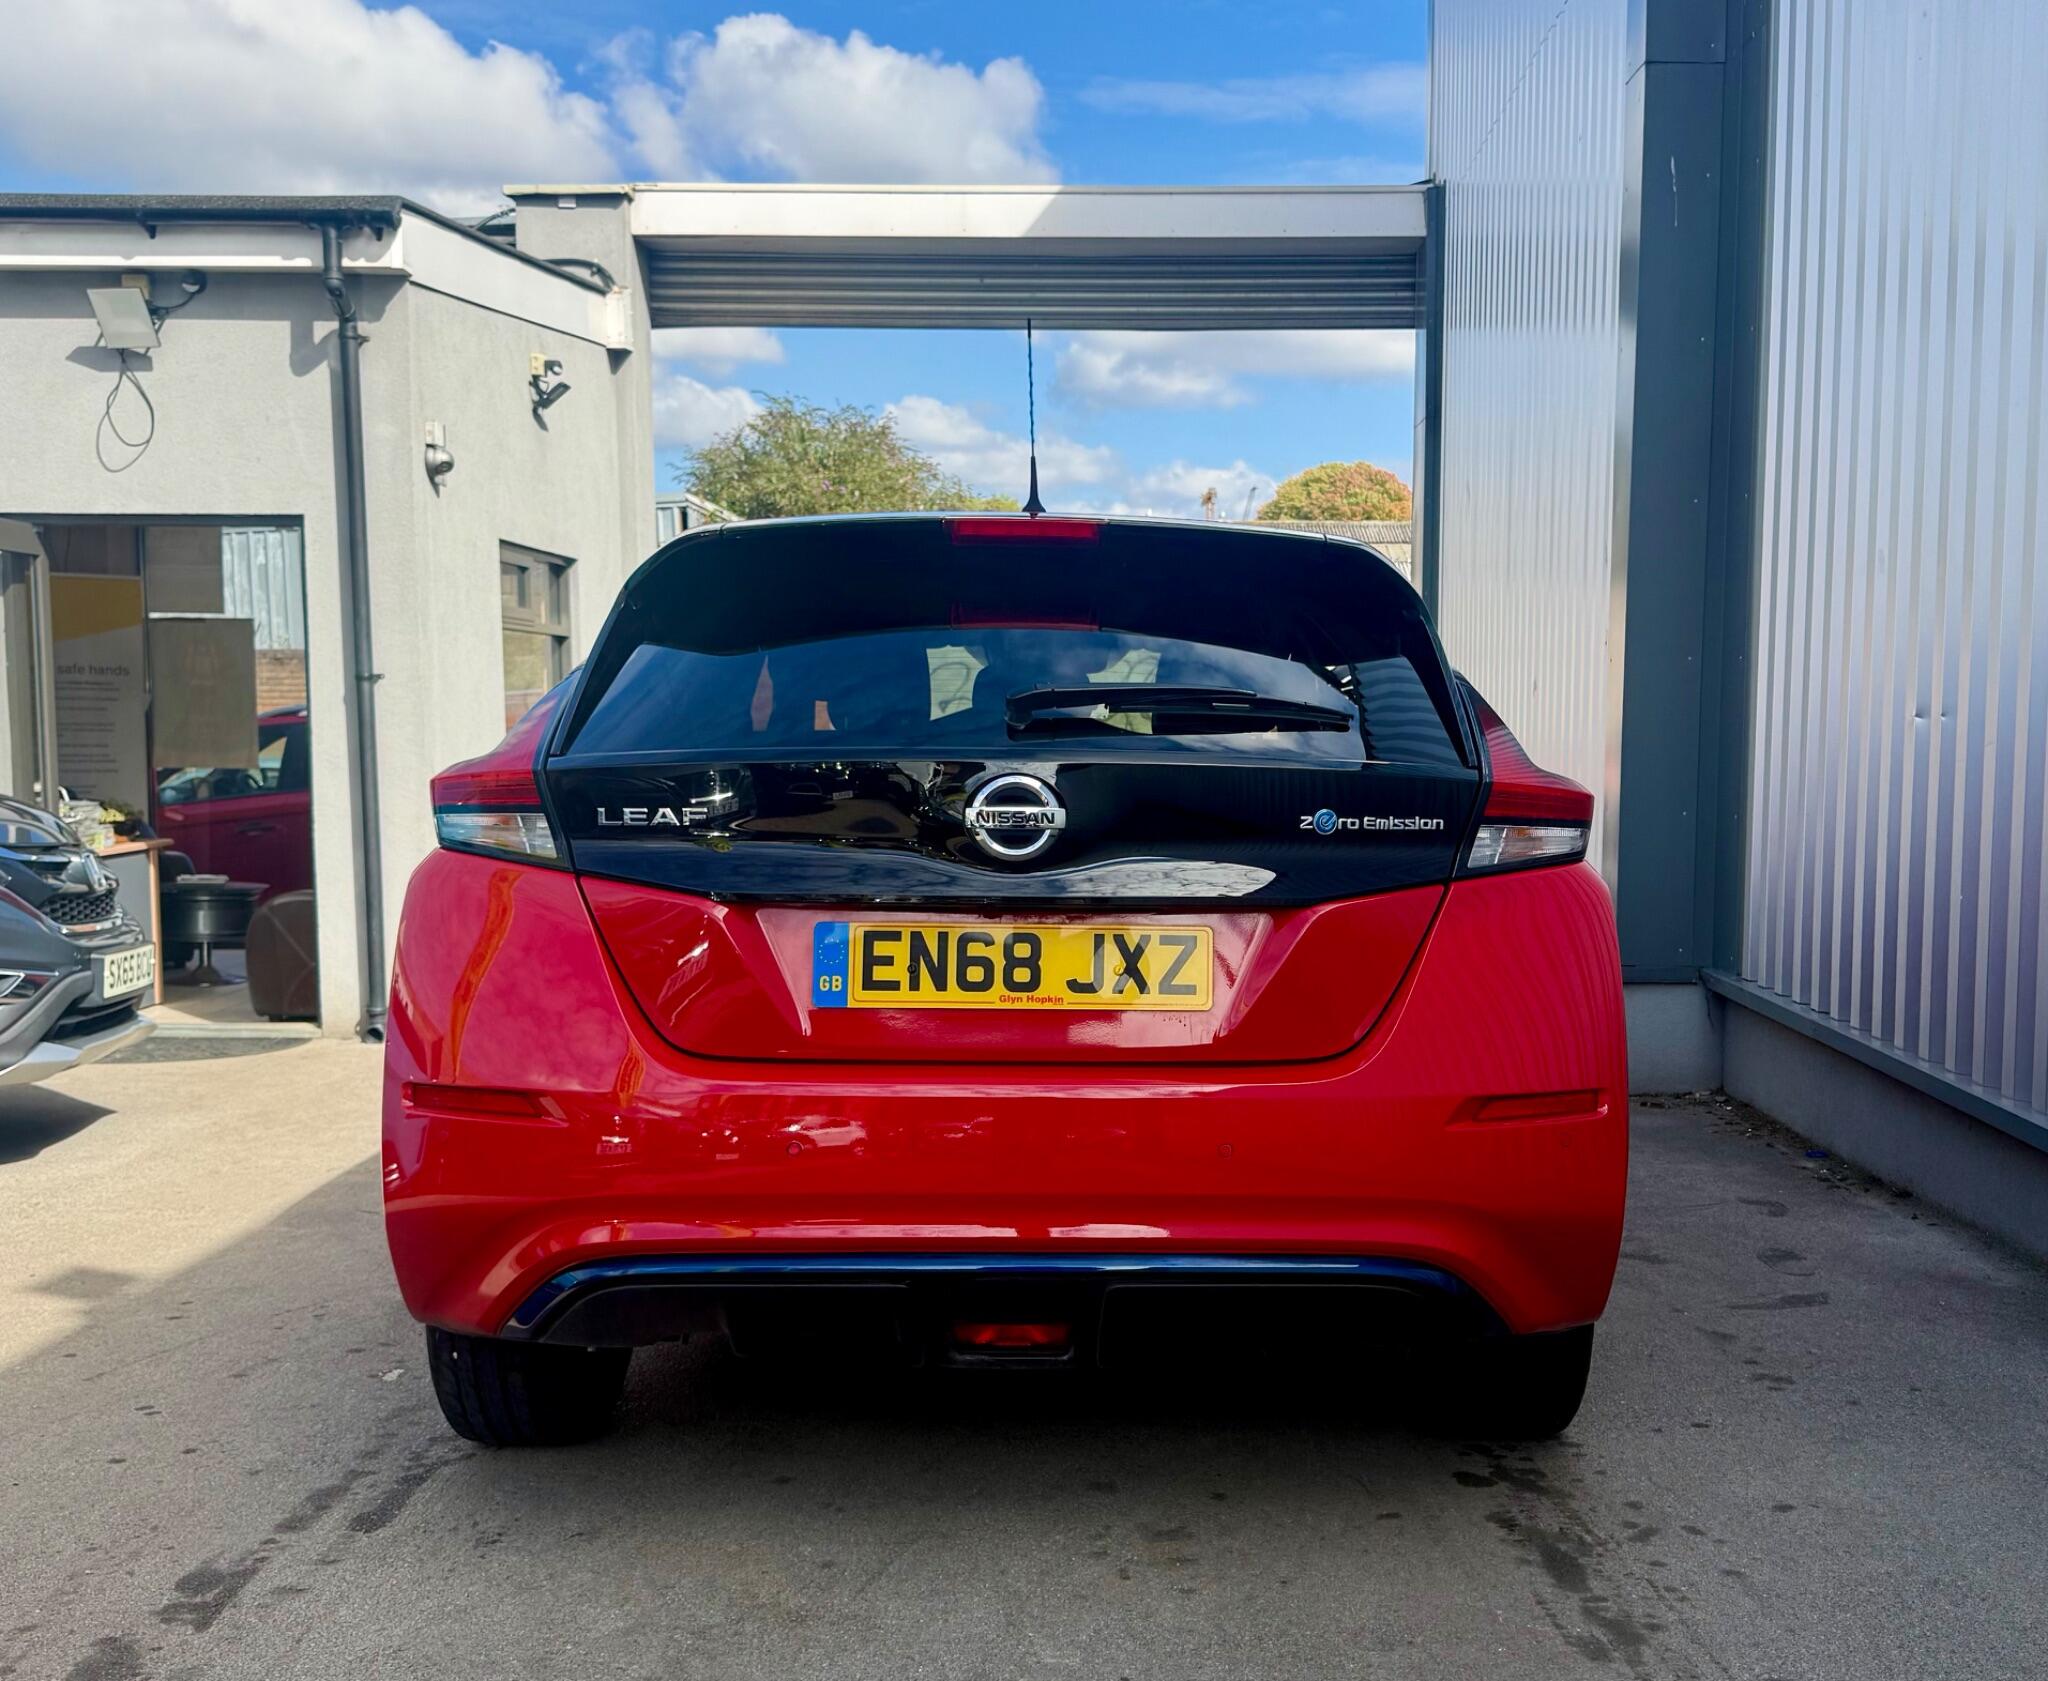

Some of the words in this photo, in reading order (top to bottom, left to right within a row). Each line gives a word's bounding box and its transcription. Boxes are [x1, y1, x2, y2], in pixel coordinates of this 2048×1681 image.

[57, 662, 86, 675] safe
[89, 663, 131, 676] hands
[597, 806, 708, 828] LEAF
[975, 810, 1056, 826] NISSAN
[1363, 816, 1444, 830] Emission
[861, 930, 1042, 993] EN68
[1066, 934, 1197, 996] JXZ
[109, 954, 135, 989] SX65
[819, 975, 841, 992] GB
[998, 994, 1023, 1005] Glyn
[1026, 995, 1064, 1006] Hopkin
